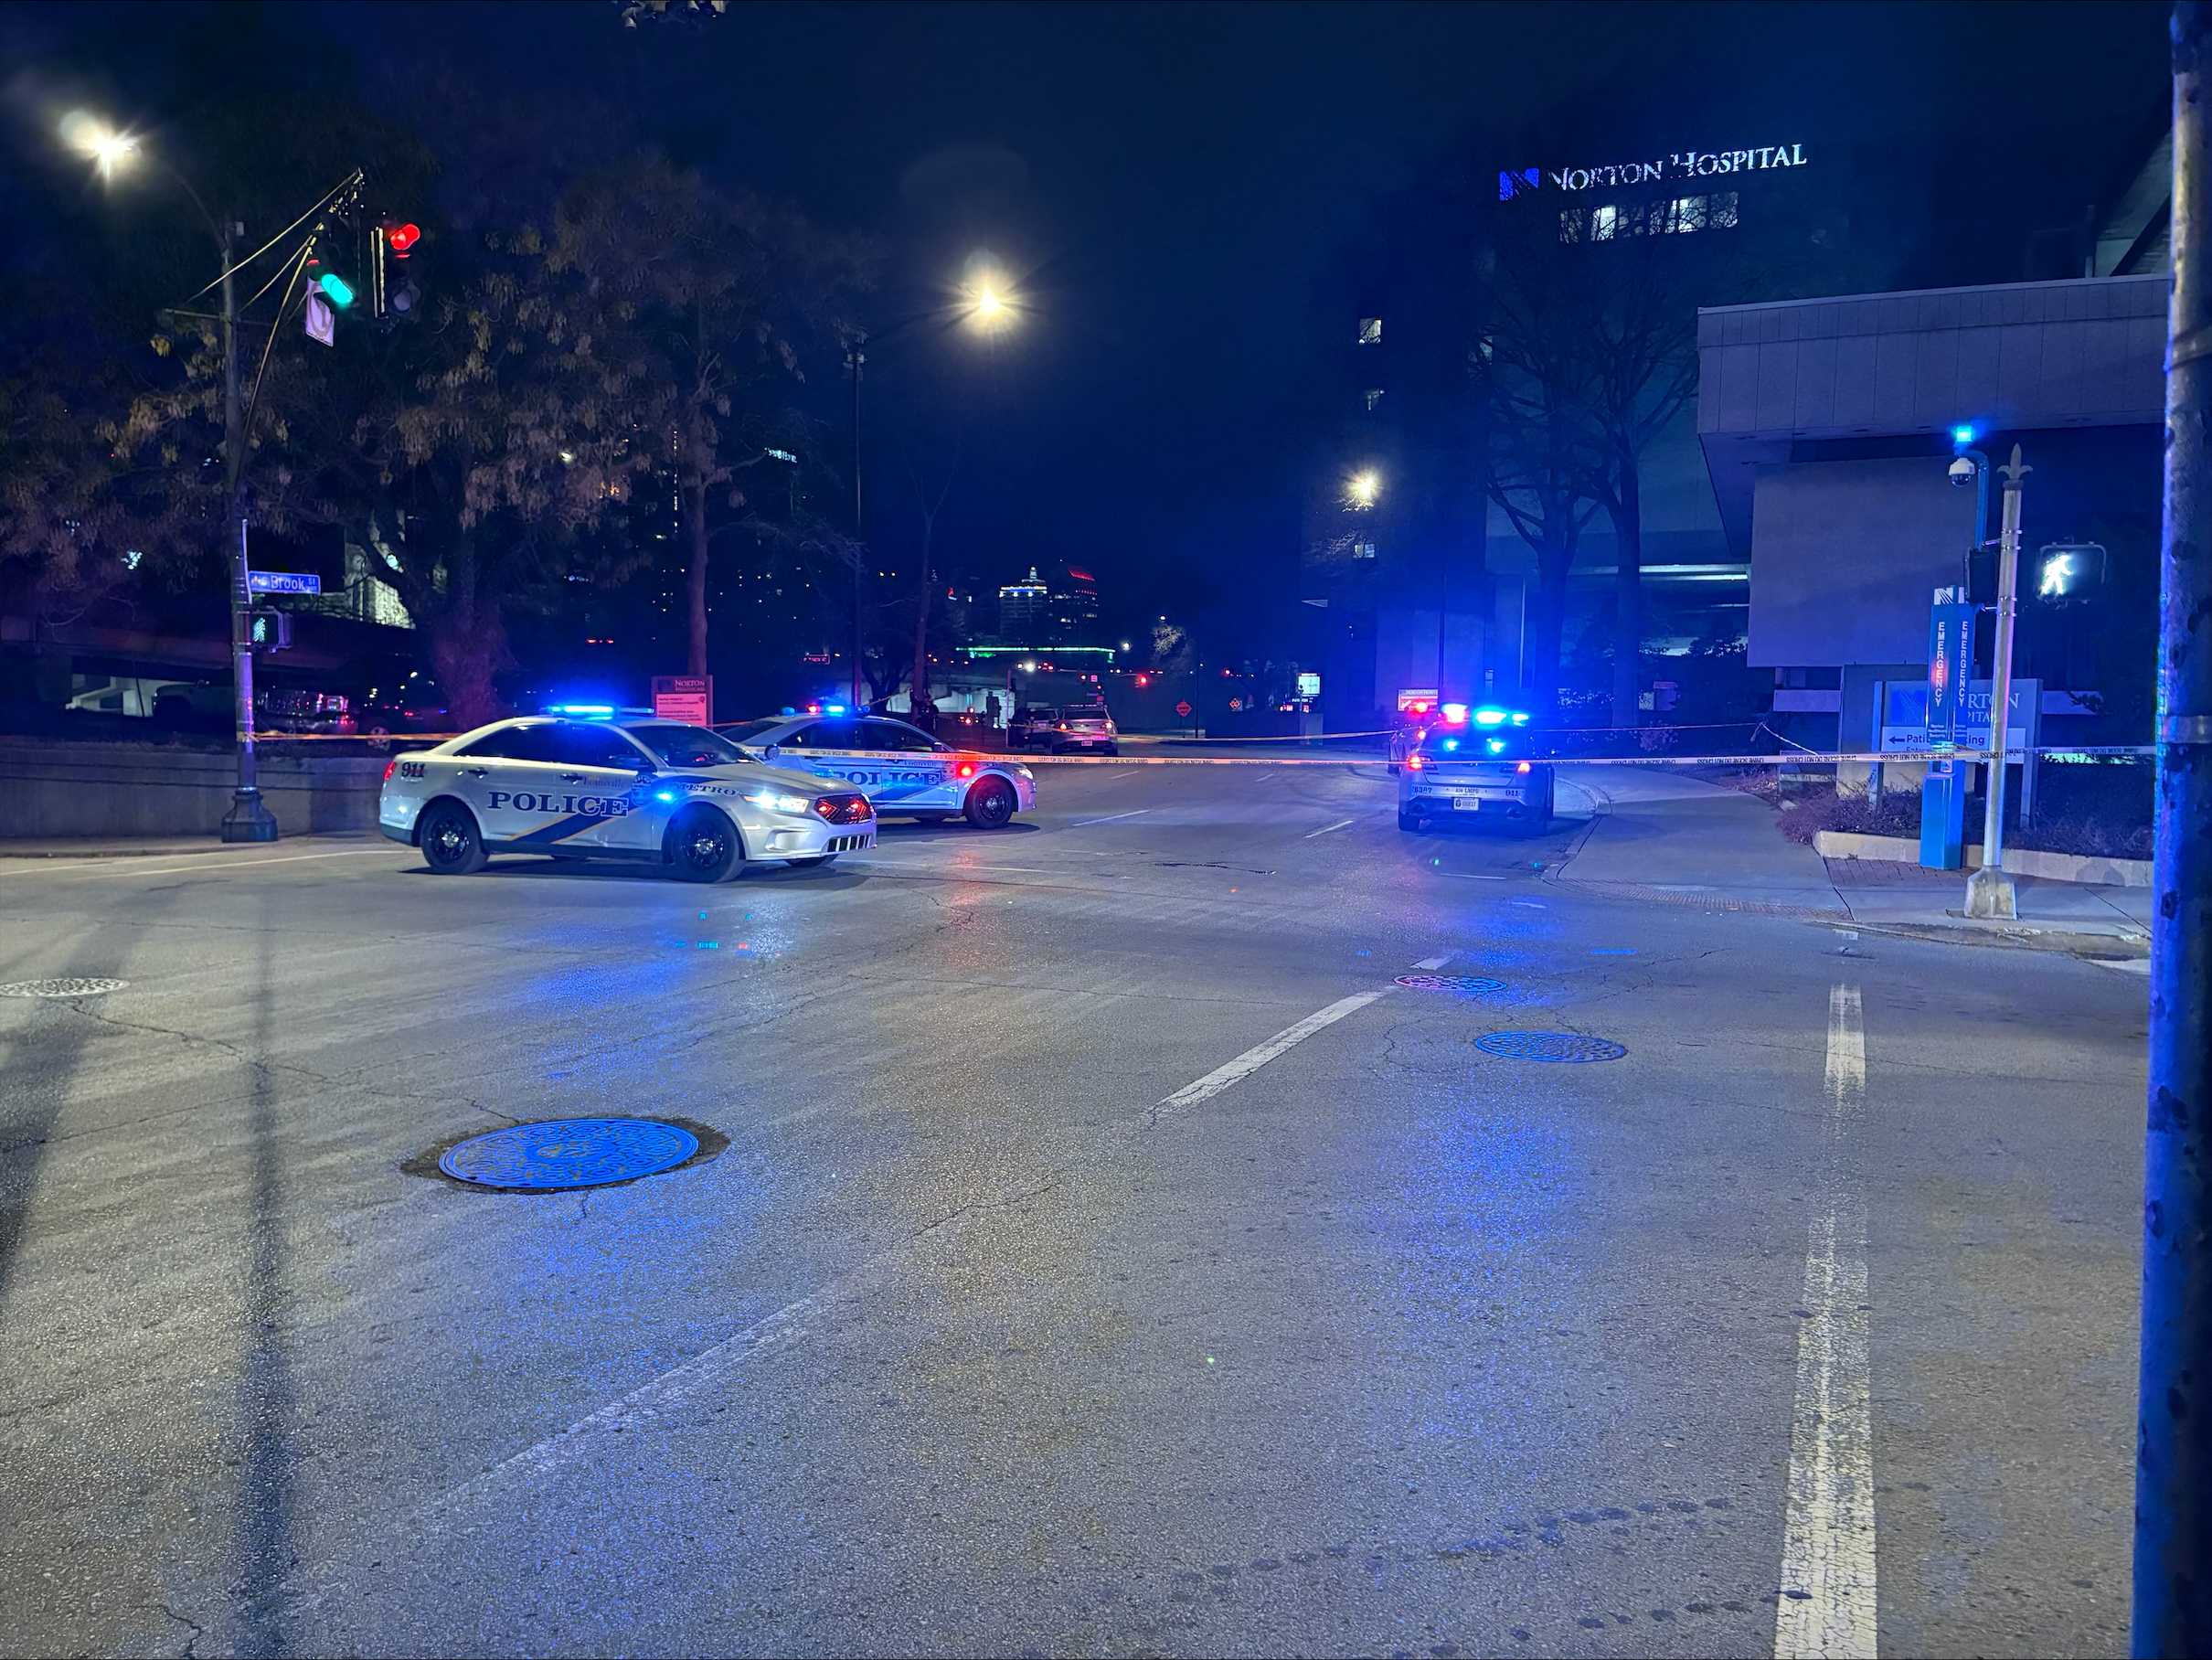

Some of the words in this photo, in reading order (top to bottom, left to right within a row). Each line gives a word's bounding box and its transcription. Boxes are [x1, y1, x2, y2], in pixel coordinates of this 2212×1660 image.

[1548, 160, 1664, 190] NORTON
[1670, 144, 1807, 178] HOSPITAL
[271, 575, 305, 591] Brook
[1935, 622, 1945, 707] EMERGENCY
[1959, 622, 1968, 707] EMERGENCY
[402, 761, 425, 777] 911
[487, 791, 629, 817] POLICE
